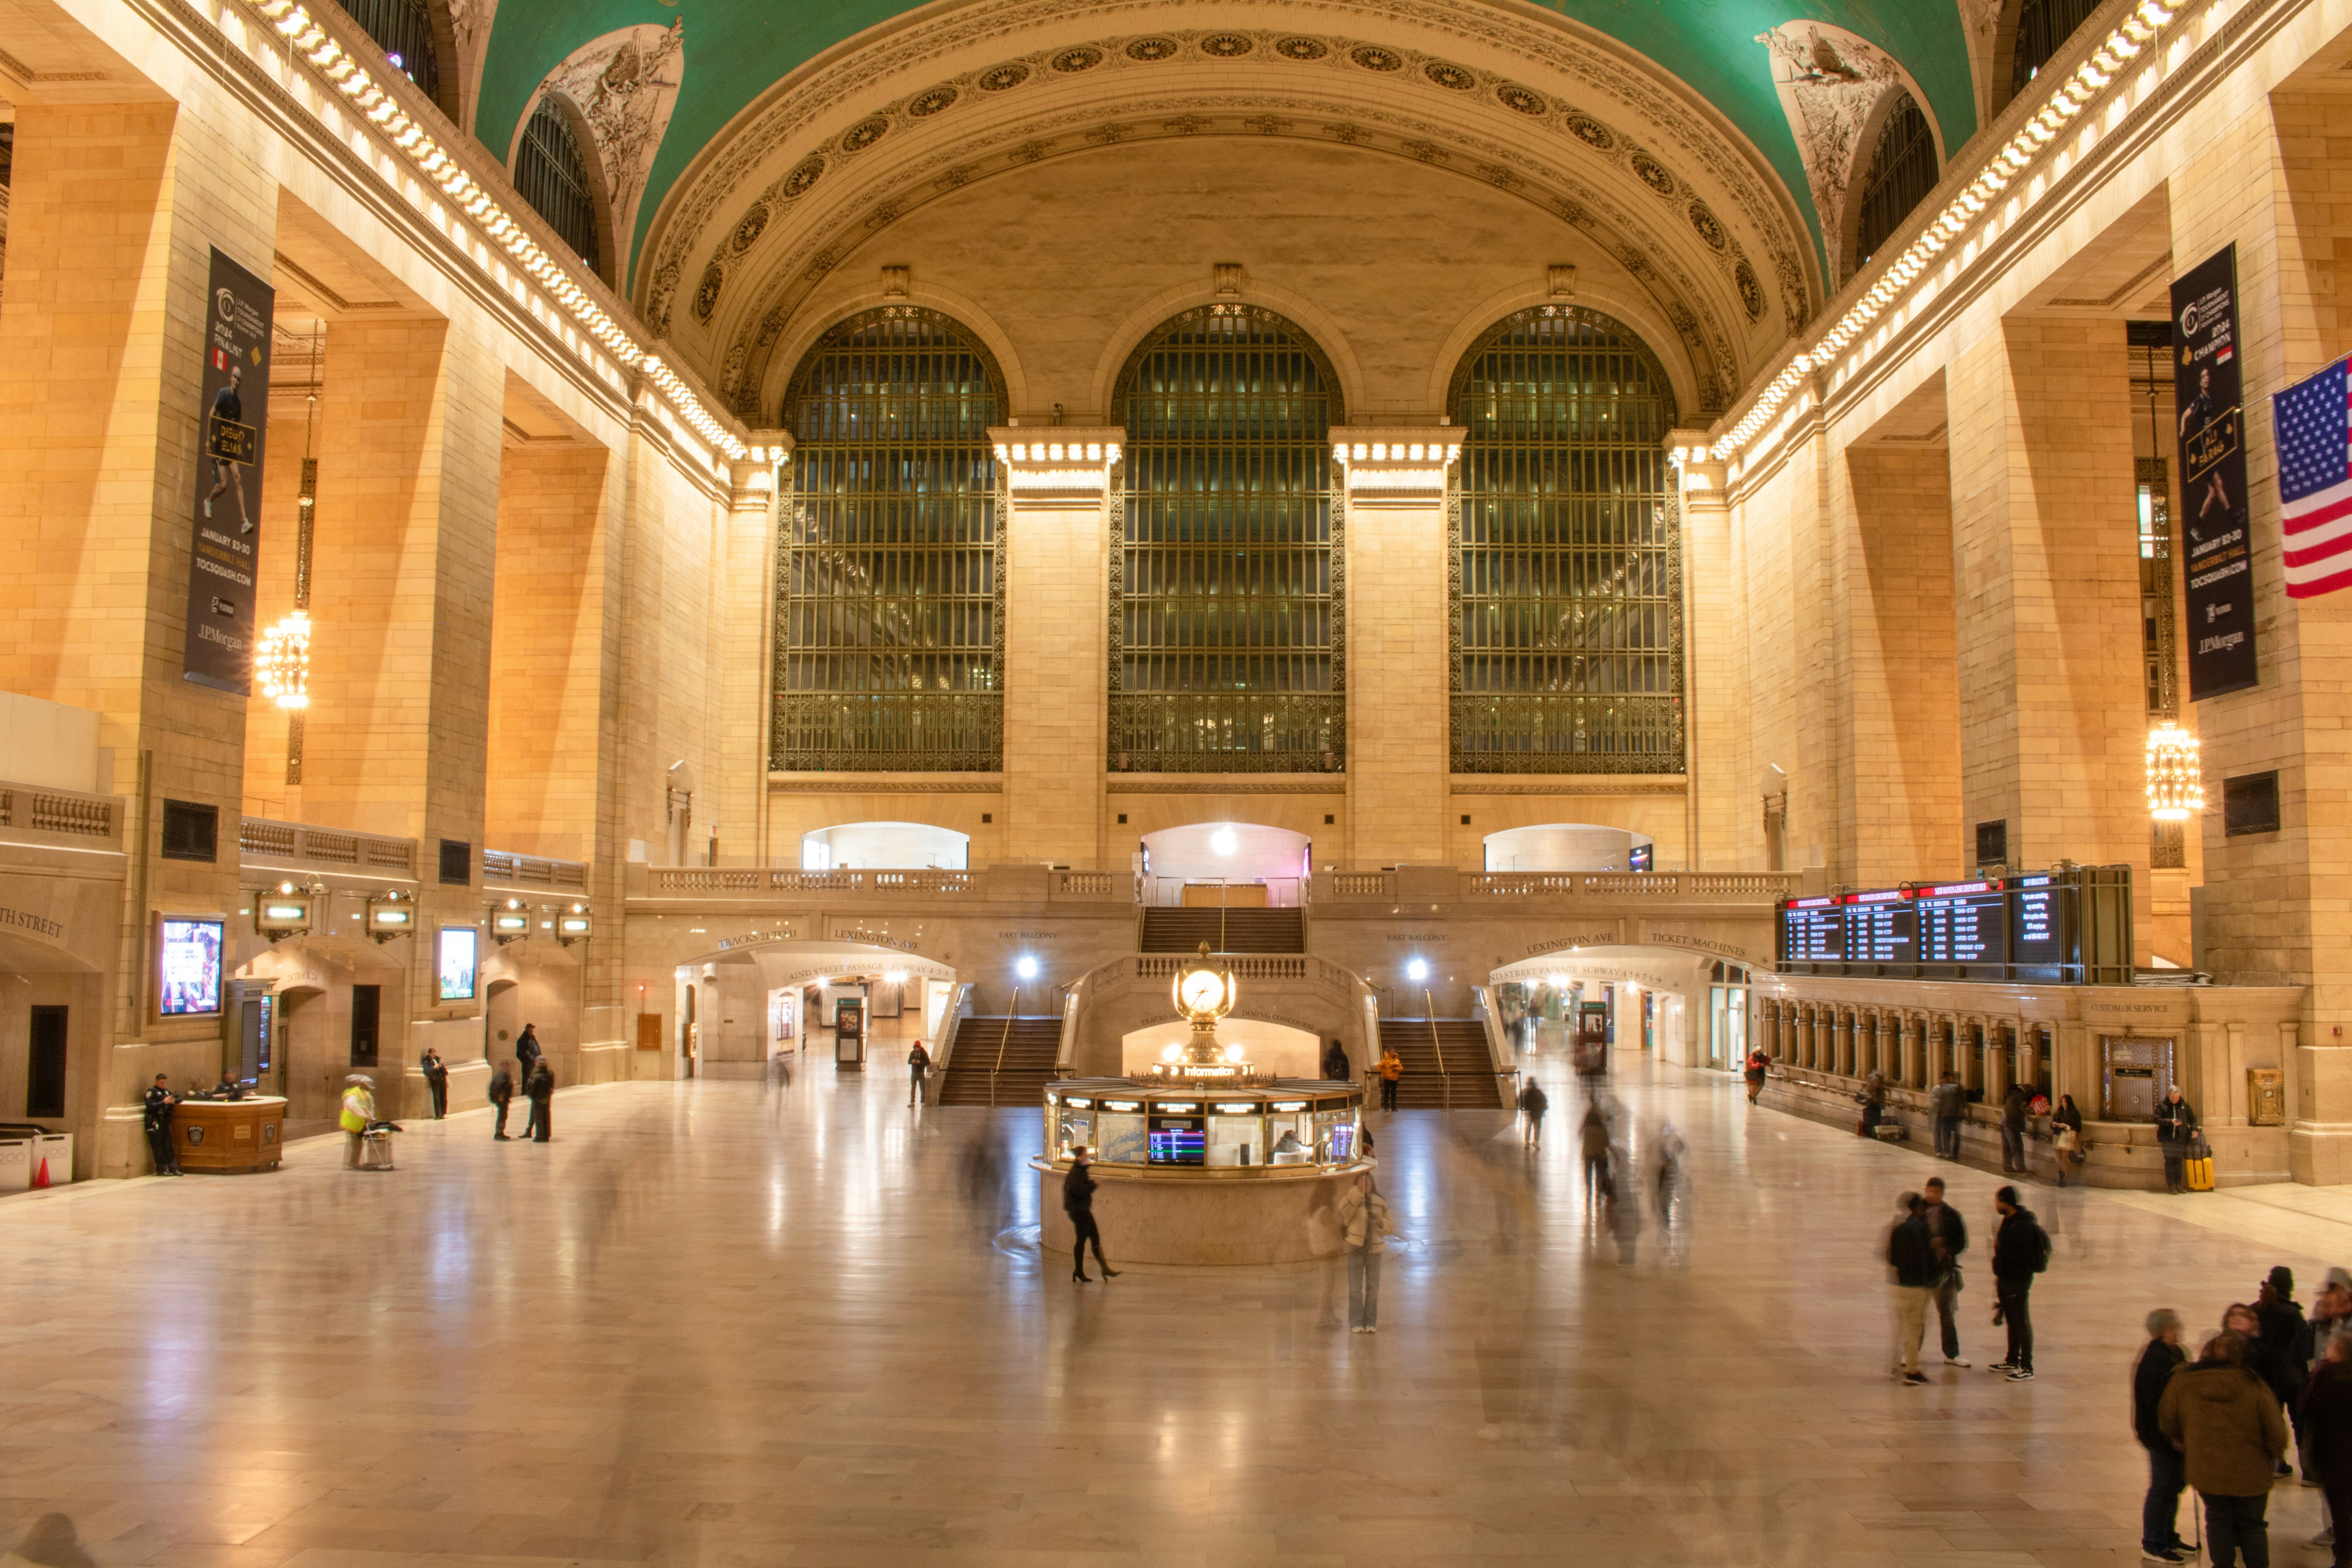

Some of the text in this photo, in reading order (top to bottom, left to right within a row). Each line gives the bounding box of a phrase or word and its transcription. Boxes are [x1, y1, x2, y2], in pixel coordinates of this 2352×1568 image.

[214, 333, 243, 358] FINALIST
[2194, 331, 2232, 361] CHAMPION
[220, 425, 245, 442] DIEGO
[221, 440, 242, 455] ELIAS
[201, 528, 231, 547] JANUARY
[2191, 537, 2221, 557] JANUARY
[197, 557, 251, 586] TOCSQUASH.COM
[18, 912, 63, 937] STREET
[718, 934, 758, 948] TRACKS
[772, 929, 786, 938] TO
[835, 929, 920, 951] LEXINGTON AVE
[1527, 933, 1613, 954] LEXINGTON AVE
[1651, 933, 1746, 956] TICKET MACHINES
[294, 972, 311, 980] TRACK
[790, 969, 811, 980] 42ND
[814, 965, 844, 975] STREET
[891, 964, 927, 973] SUBWAY
[1504, 968, 1537, 979] STREET
[1583, 967, 1620, 975] SUBWAY
[2091, 1004, 2132, 1012] CUSTOMER
[1141, 1014, 1168, 1025] TRACKS
[1242, 1010, 1270, 1019] DINING
[1272, 1014, 1315, 1030] CONCOURSE
[1185, 1066, 1234, 1076] Information
[0, 1153, 25, 1162] 200
[43, 1147, 67, 1156] 200
